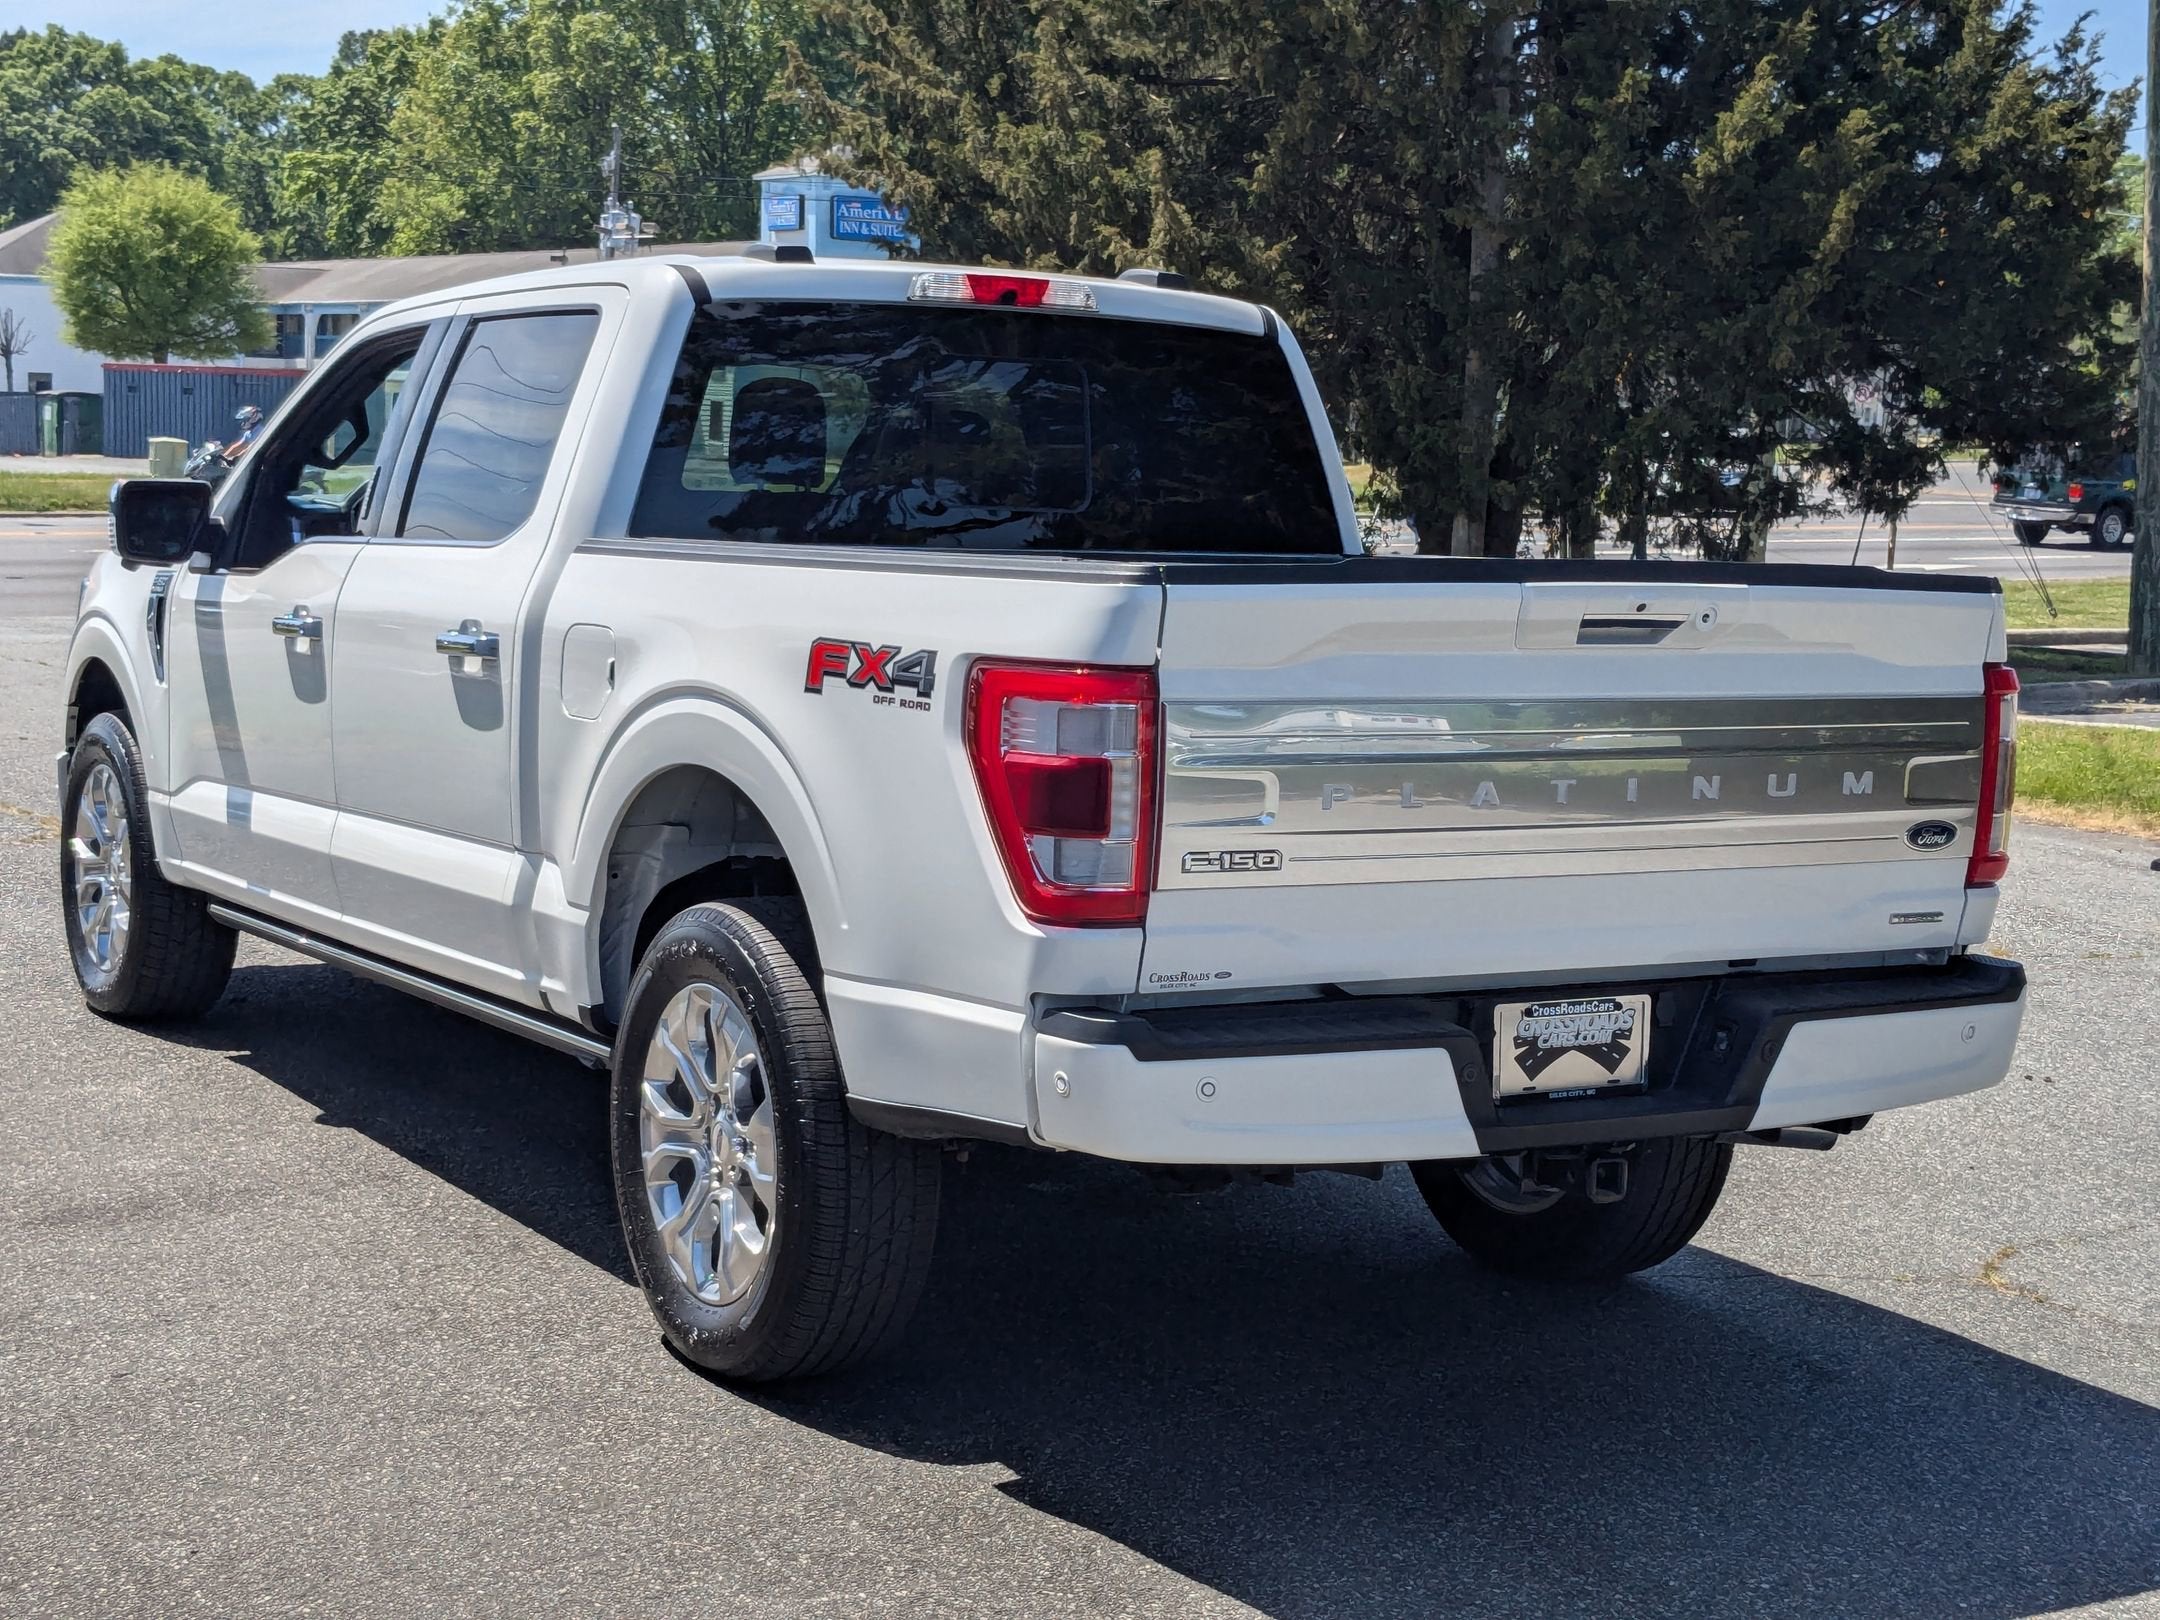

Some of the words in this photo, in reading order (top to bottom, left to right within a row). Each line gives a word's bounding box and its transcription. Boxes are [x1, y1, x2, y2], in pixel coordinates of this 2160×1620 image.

[840, 221, 860, 234] INN
[861, 223, 870, 235] &
[804, 637, 939, 699] FX4
[872, 695, 896, 706] OFF
[899, 698, 931, 712] ROAD
[1322, 771, 1873, 811] PLATINUM
[1917, 828, 1948, 845] Ford
[1181, 849, 1283, 873] F-150
[1532, 1001, 1615, 1017] CrossRoadsCars
